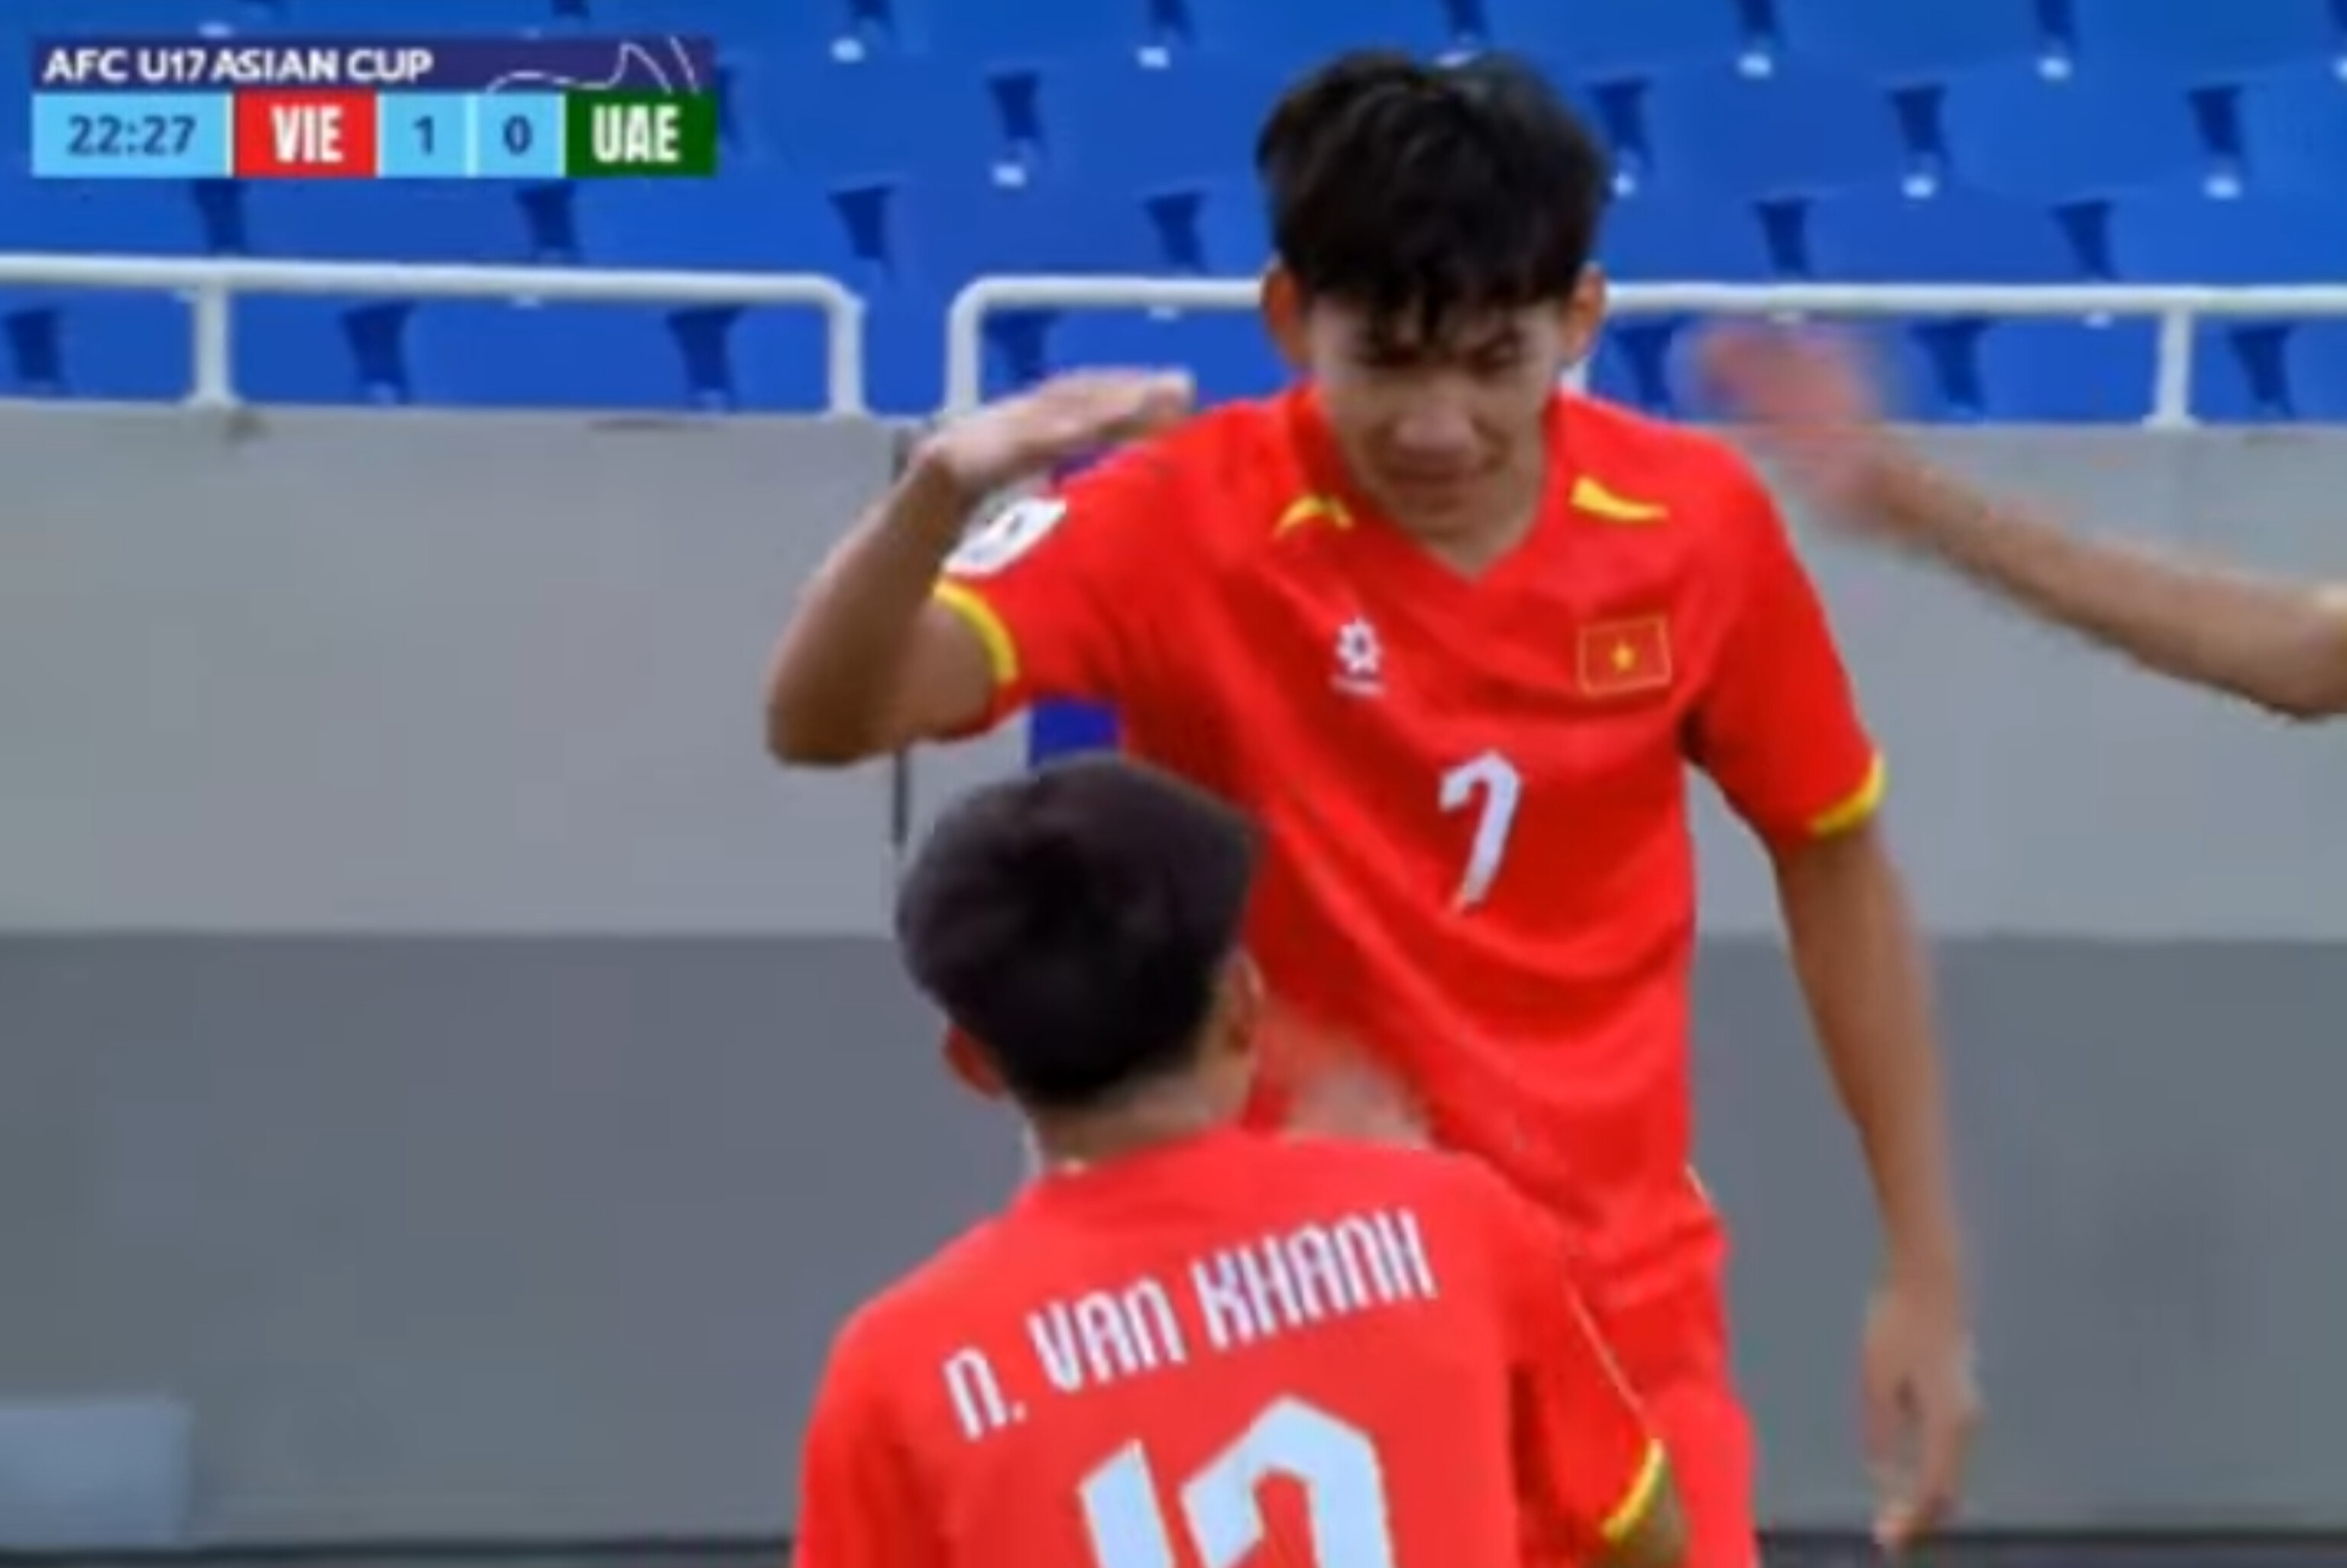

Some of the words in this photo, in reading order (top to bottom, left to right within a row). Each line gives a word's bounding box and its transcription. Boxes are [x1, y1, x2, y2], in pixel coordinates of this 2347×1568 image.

[1439, 748, 1520, 904] 7
[1026, 1276, 1189, 1392] VAN
[1190, 1206, 1439, 1351] KHANH
